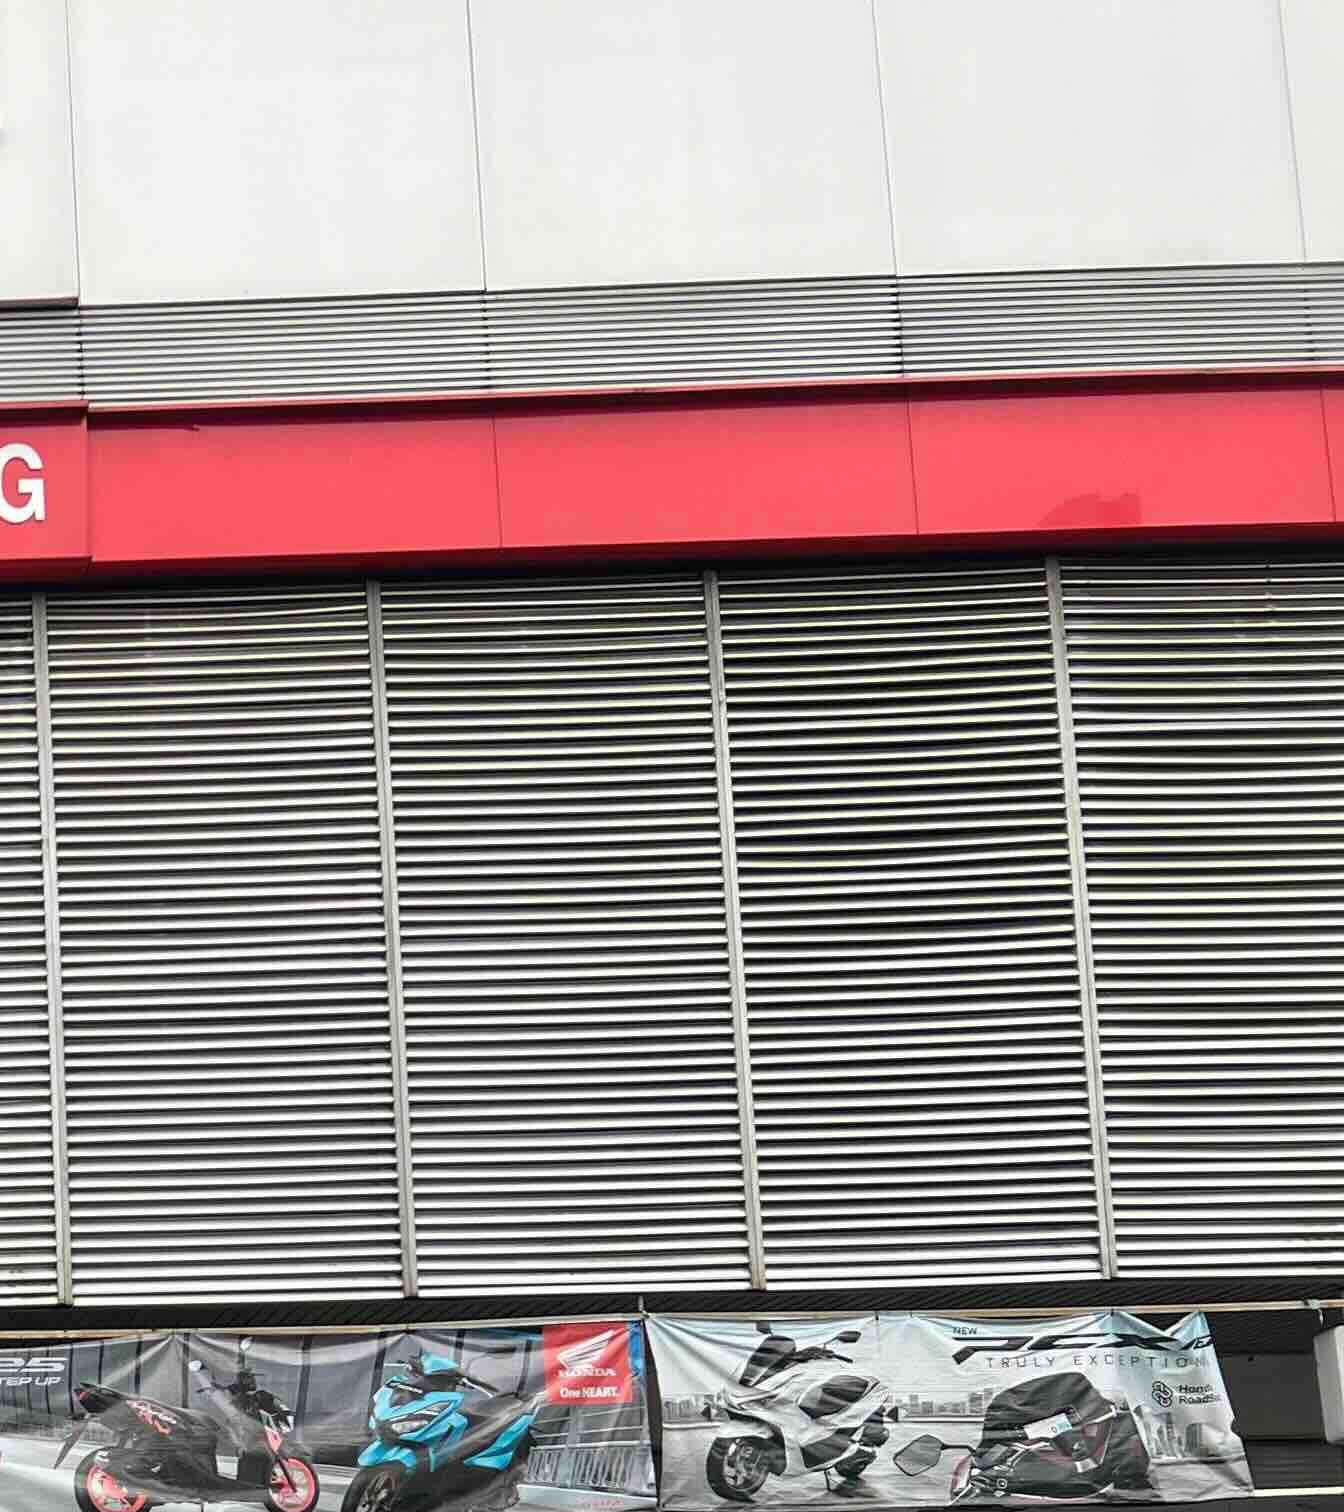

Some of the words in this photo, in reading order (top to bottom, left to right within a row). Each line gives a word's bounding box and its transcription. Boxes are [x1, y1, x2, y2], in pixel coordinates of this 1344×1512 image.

[953, 1326, 978, 1335] NEW
[985, 1356, 1056, 1368] TRULY
[559, 1367, 617, 1377] HONDA
[34, 1376, 61, 1386] UP
[560, 1388, 581, 1398] One
